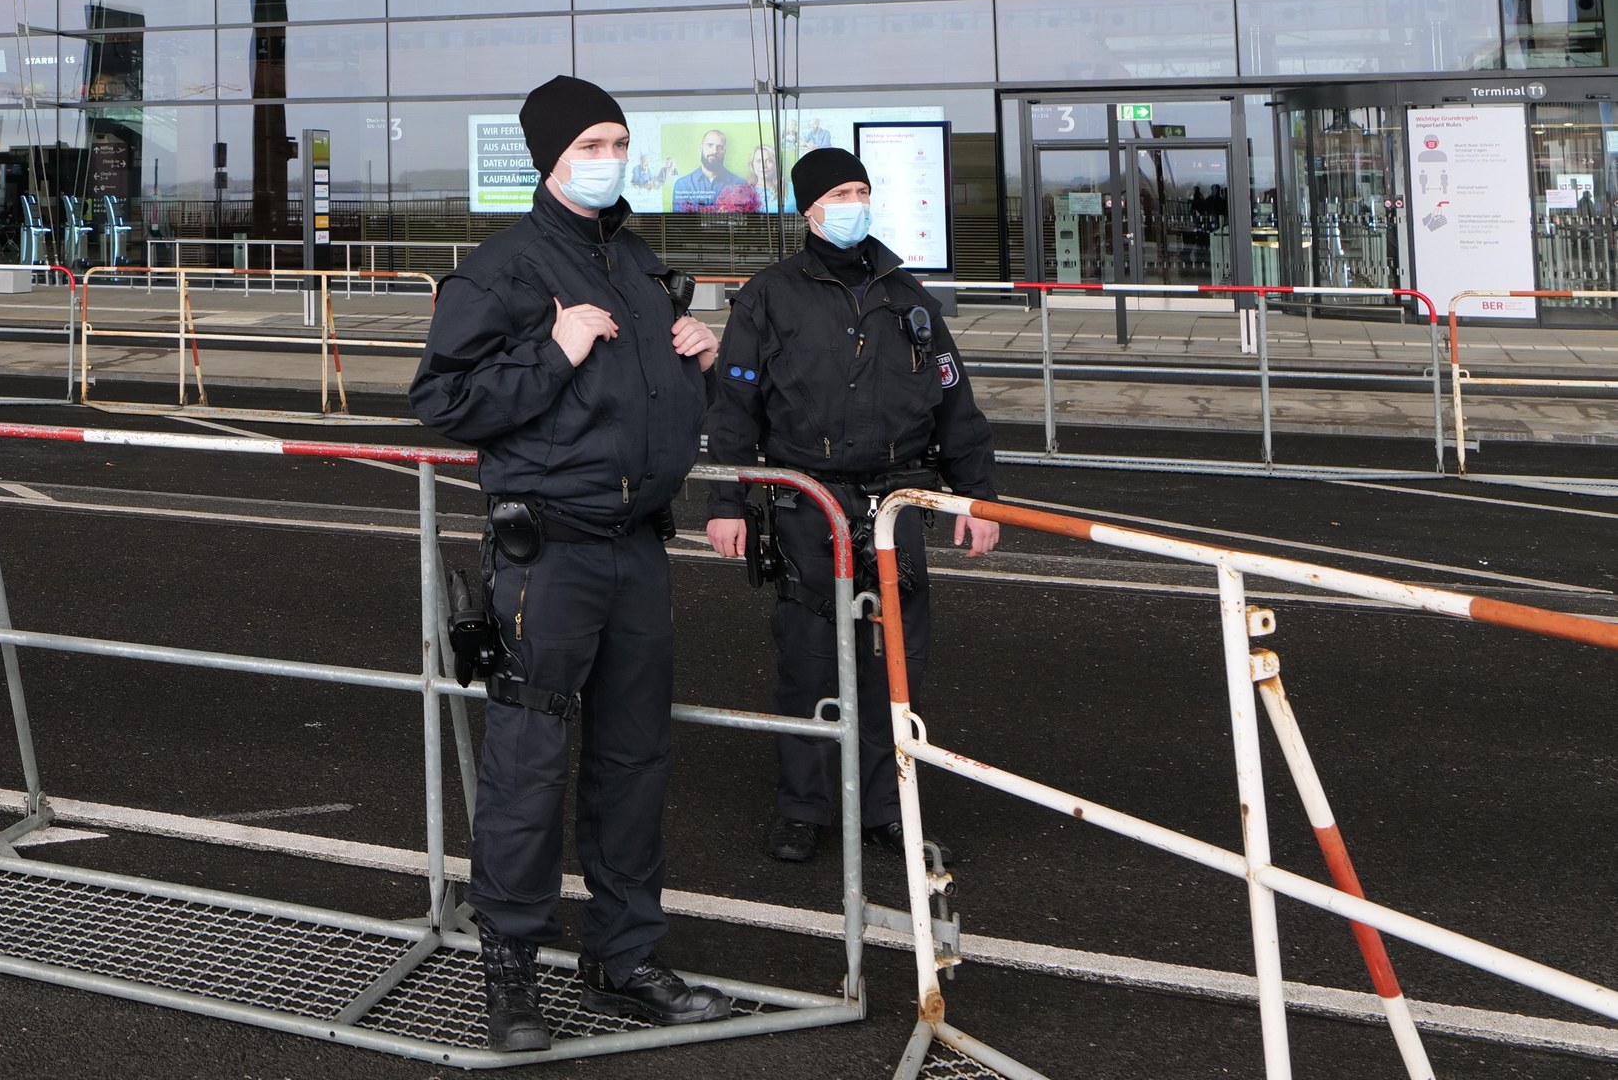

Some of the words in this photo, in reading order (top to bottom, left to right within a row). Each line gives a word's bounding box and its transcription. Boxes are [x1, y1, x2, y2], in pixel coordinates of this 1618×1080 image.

[25, 56, 75, 65] STARBKS
[1471, 86, 1526, 97] Terminal
[1529, 86, 1544, 95] T1
[1057, 106, 1075, 132] 3
[390, 118, 403, 141] 3
[483, 127, 499, 135] WIR
[483, 143, 499, 151] AUS
[501, 143, 525, 151] ALTEN
[483, 159, 508, 167] DATEV
[483, 174, 540, 184] KAUFMÄNNISC
[1482, 301, 1503, 310] BER
